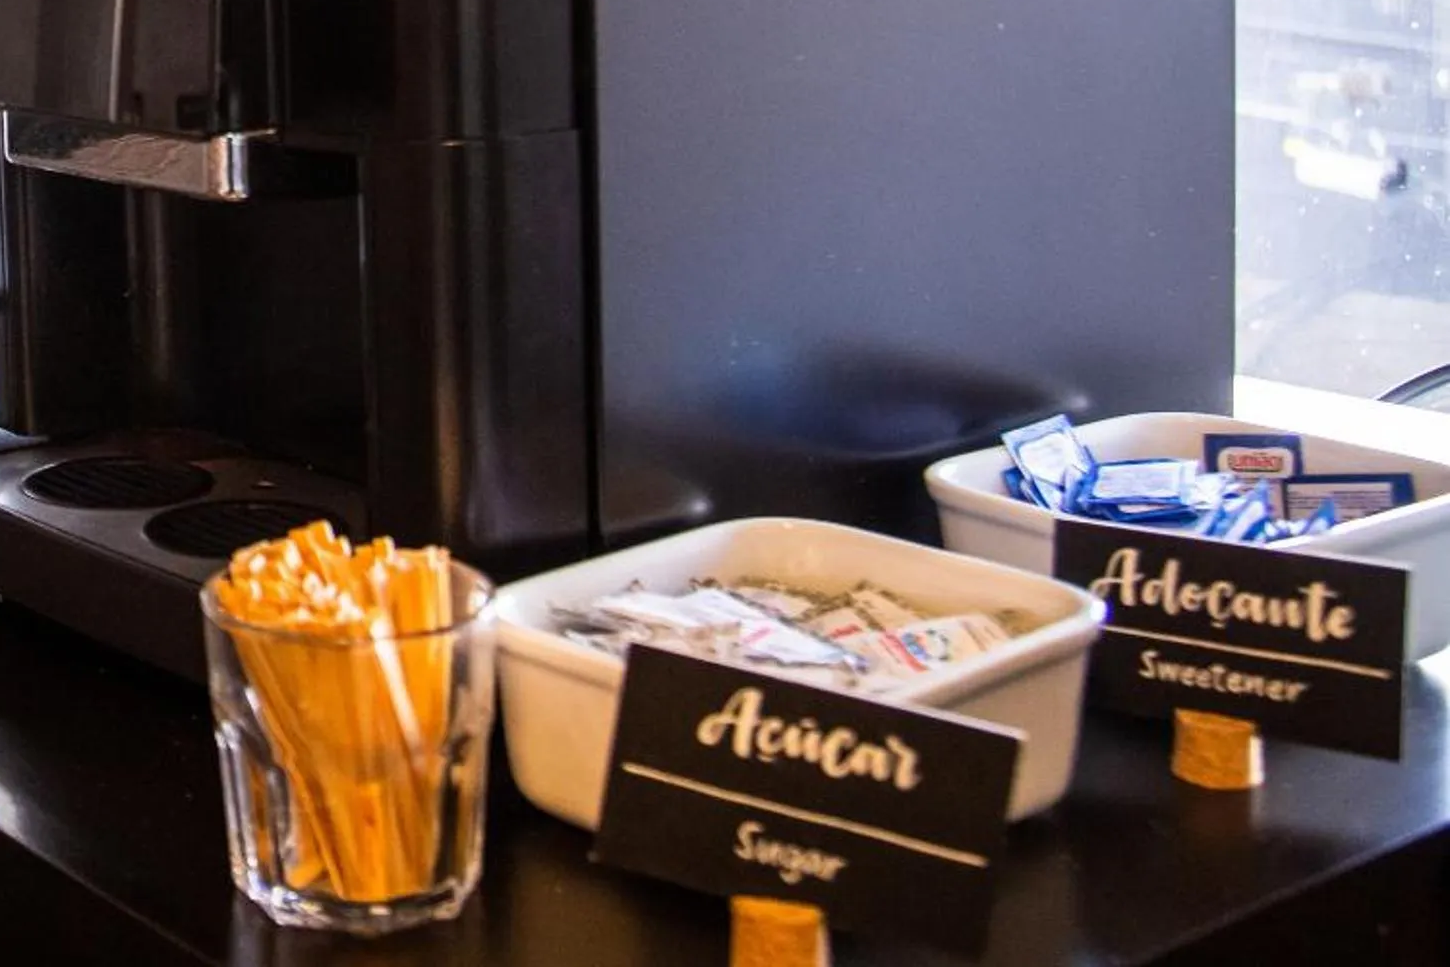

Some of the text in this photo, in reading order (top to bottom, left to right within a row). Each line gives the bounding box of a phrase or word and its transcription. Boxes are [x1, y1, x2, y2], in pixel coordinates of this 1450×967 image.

[1090, 546, 1357, 643] Adoçante
[1138, 649, 1308, 702] Sweetener
[697, 686, 921, 791] Açúcar
[733, 820, 847, 885] Sugar
